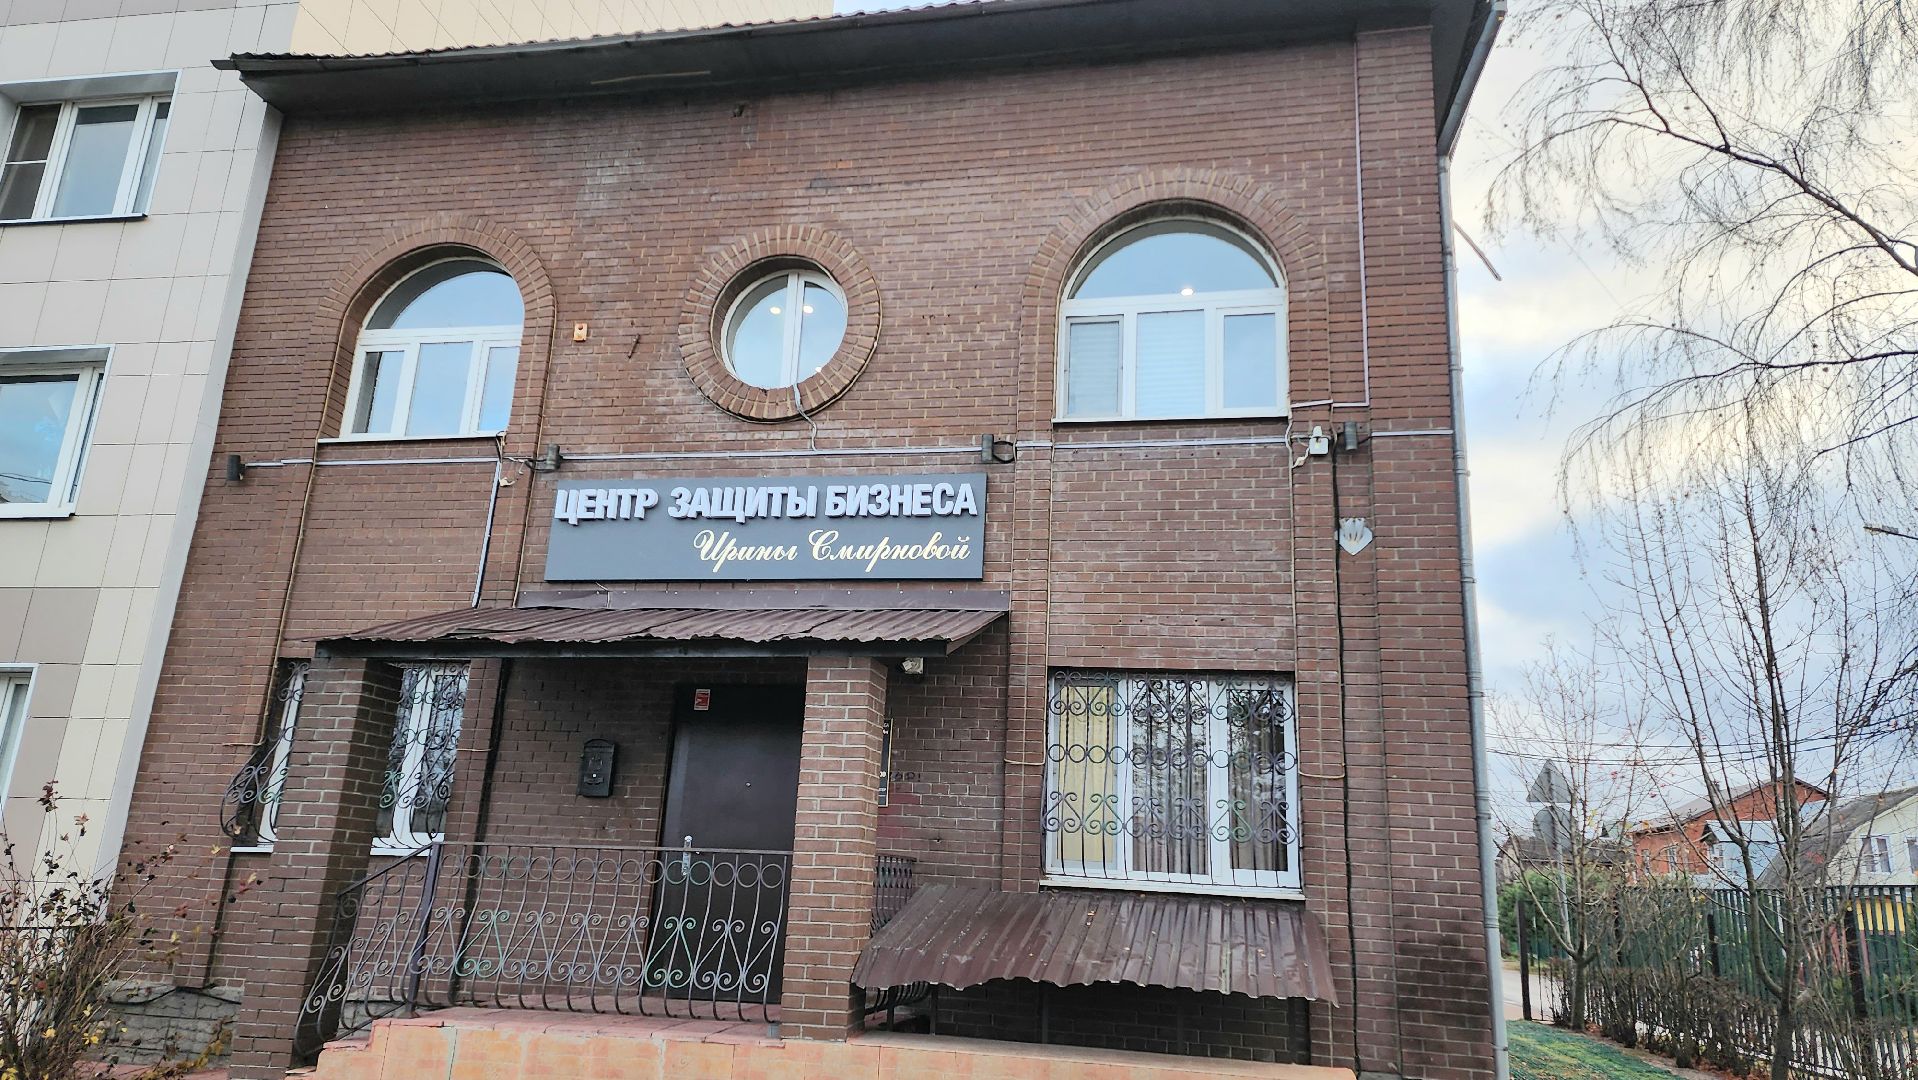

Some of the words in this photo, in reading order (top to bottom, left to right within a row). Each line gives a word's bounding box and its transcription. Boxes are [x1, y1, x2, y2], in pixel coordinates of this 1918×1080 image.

[554, 488, 659, 526] ЦЕНТР
[667, 485, 818, 524] ЗАЩИТЫ
[824, 482, 978, 518] БИЗНЕСА
[694, 529, 798, 573] Ирины
[808, 529, 970, 573] Смирновой
